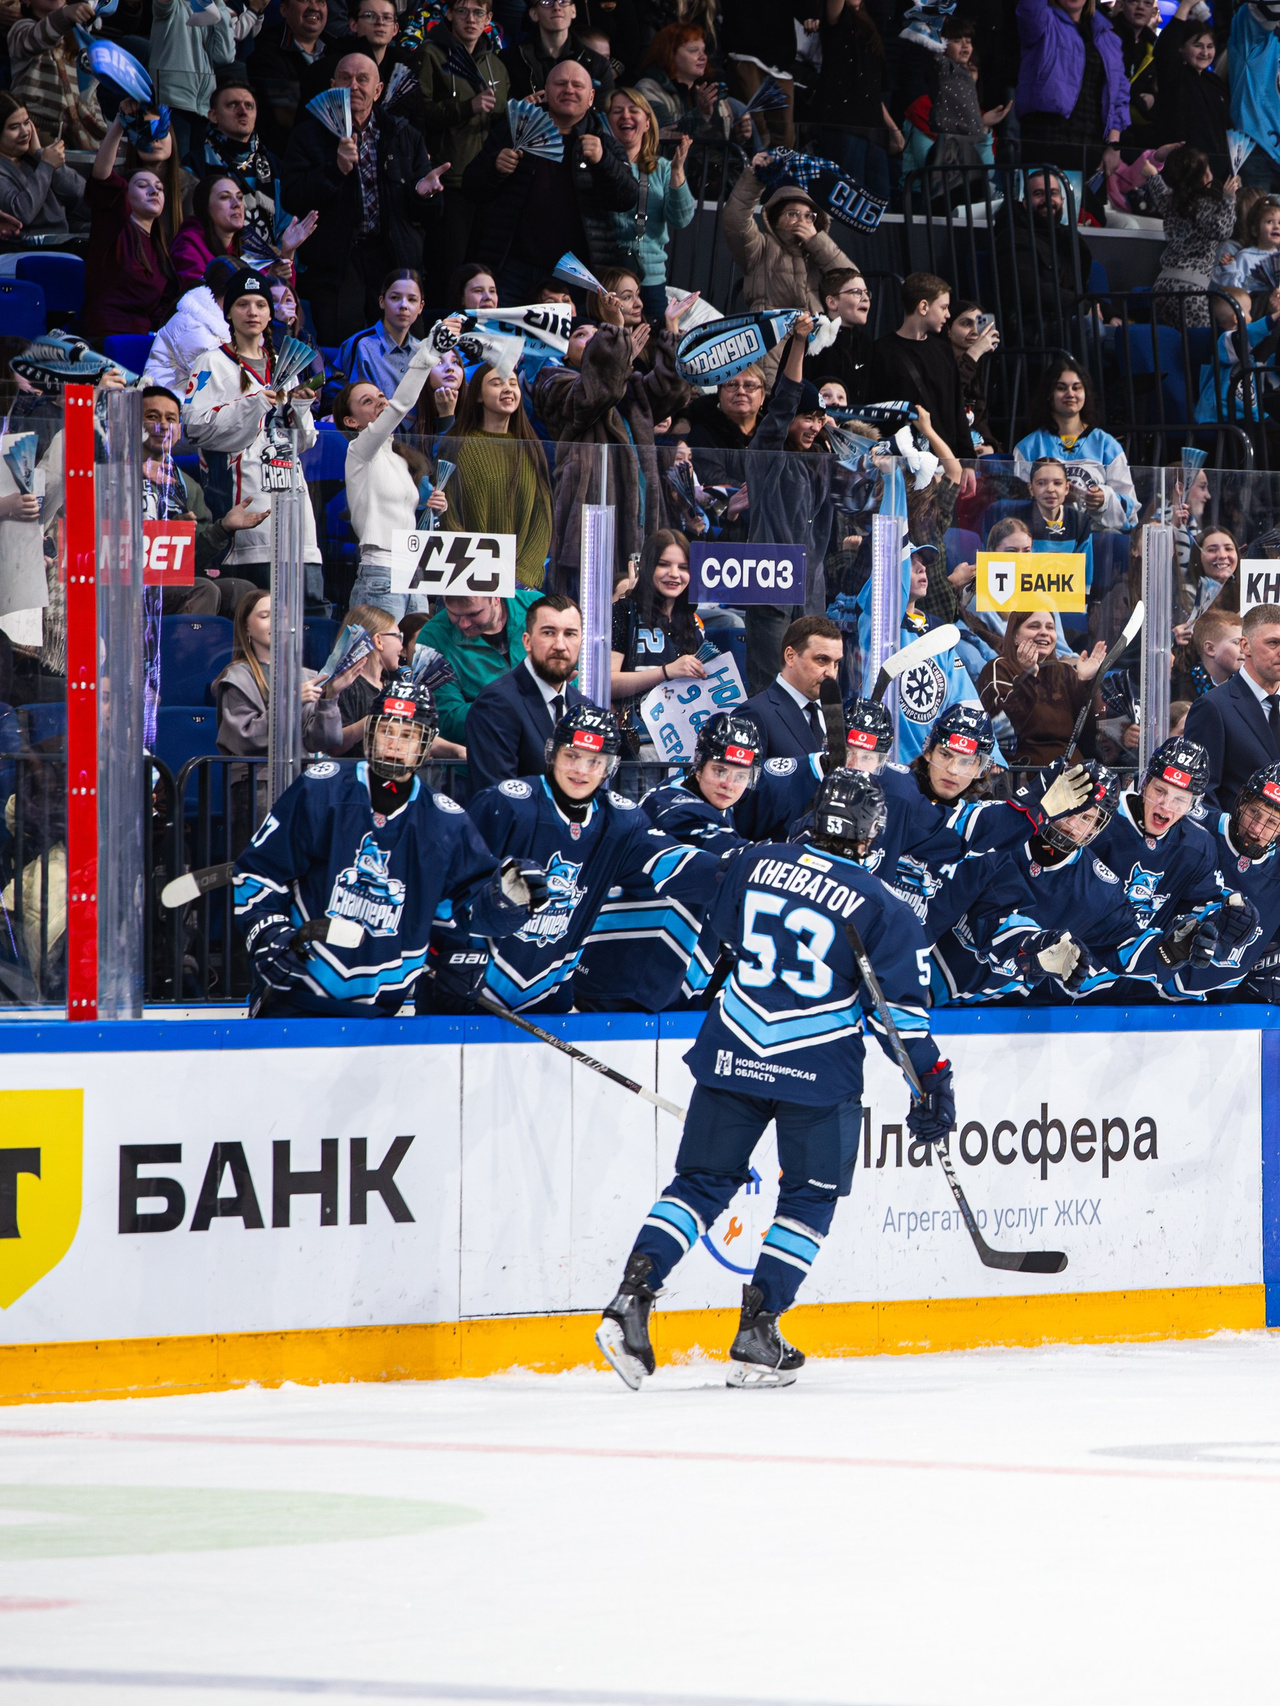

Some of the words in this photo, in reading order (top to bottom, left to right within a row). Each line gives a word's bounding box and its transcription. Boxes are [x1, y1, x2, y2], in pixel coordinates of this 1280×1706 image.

[678, 328, 760, 377] СИБИРСКИ
[1021, 573, 1075, 593] БАНК
[585, 715, 602, 727] 97
[864, 714, 873, 728] 9
[735, 730, 749, 745] 66
[1176, 752, 1193, 768] 87
[826, 818, 843, 836] 53
[748, 858, 866, 919] KHEIBATOV
[737, 888, 836, 999] 53
[915, 948, 931, 987] 5
[735, 1057, 817, 1082] НОВОСИБИРСКАЯ
[735, 1068, 776, 1083] ОБЛАСТЬ
[861, 1102, 1159, 1181] лаосфера
[118, 1135, 416, 1234] БАНК
[882, 1204, 988, 1239] Агрегатр
[993, 1204, 1050, 1236] услуг
[1054, 1199, 1103, 1227] ЖКХ
